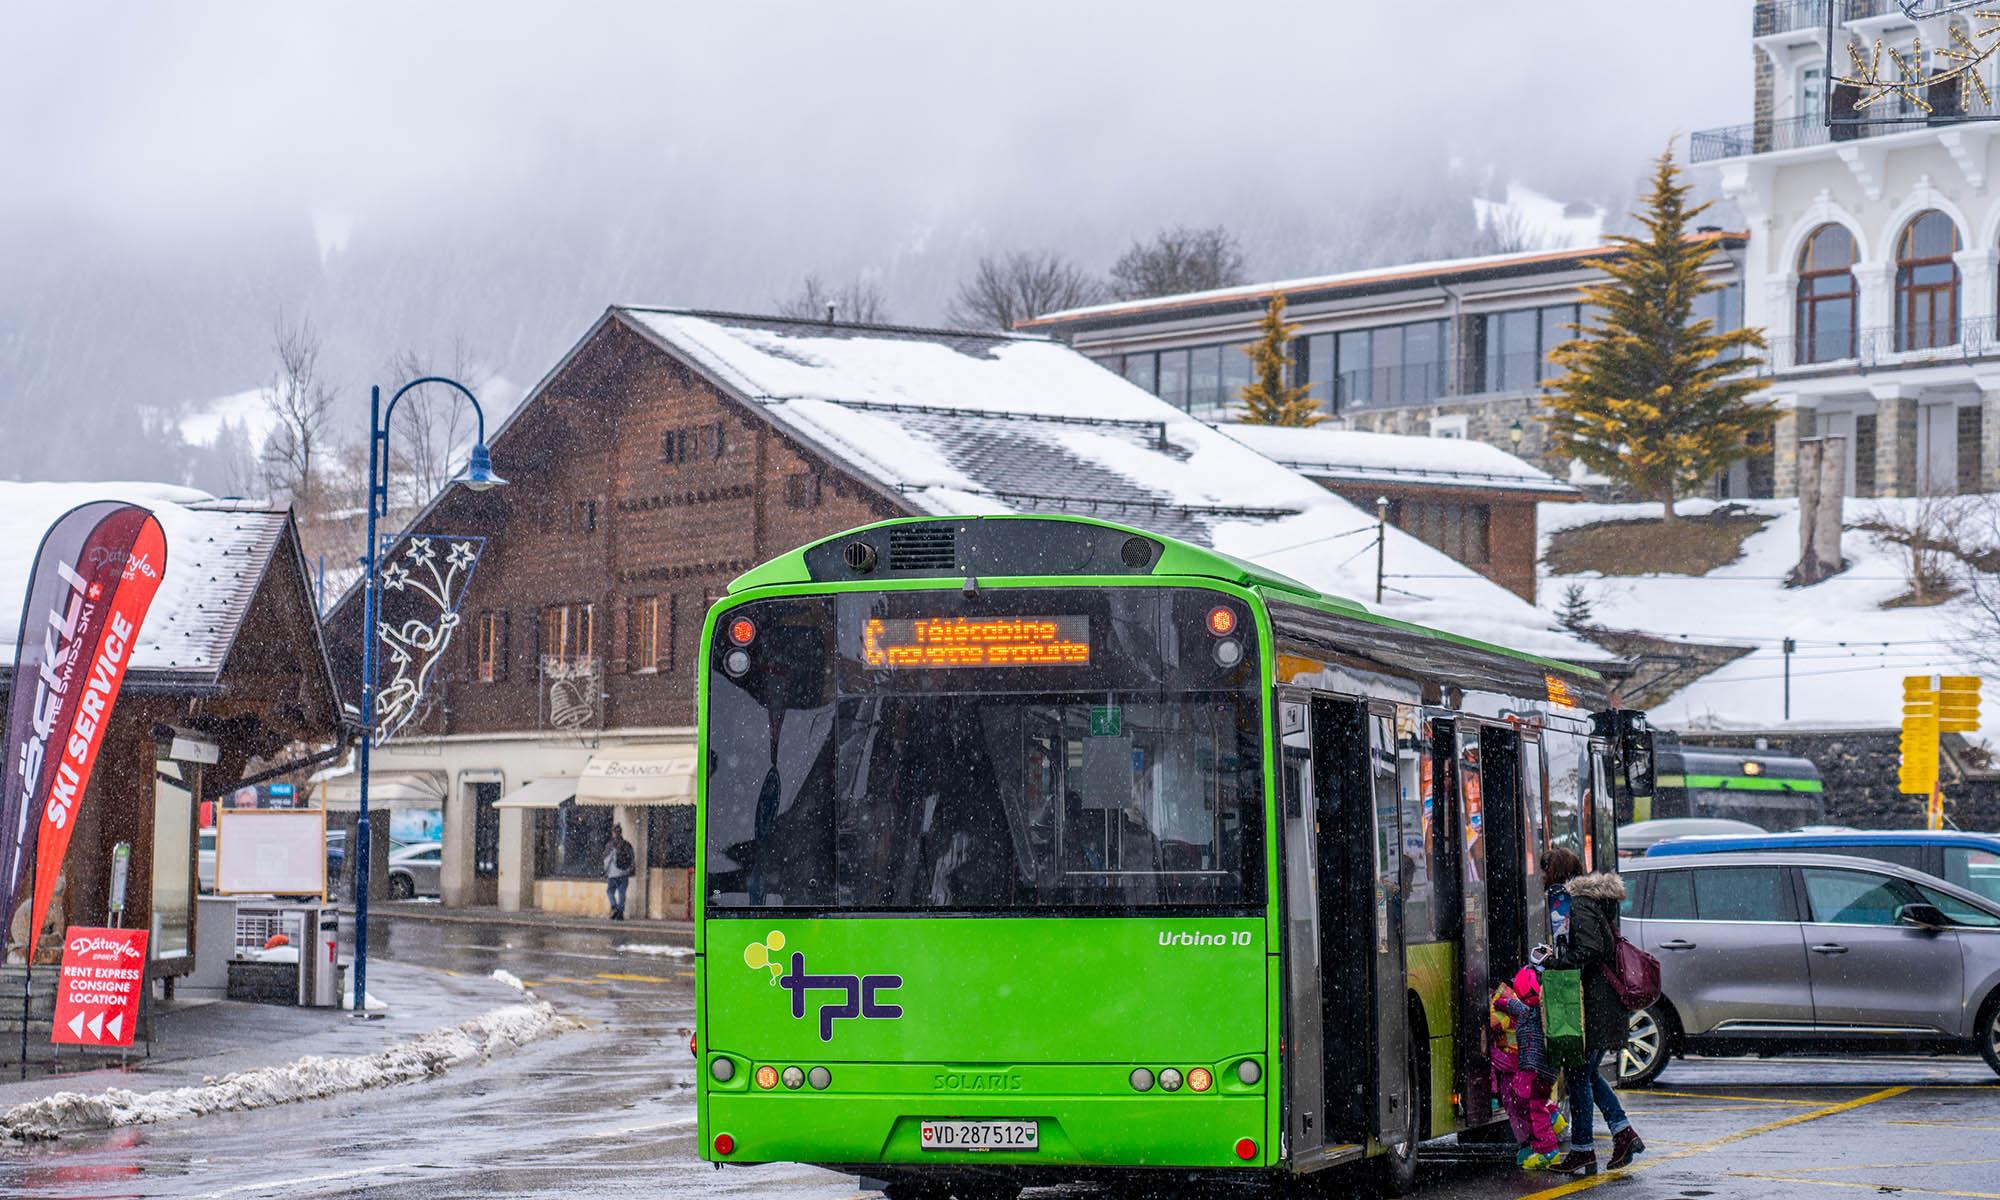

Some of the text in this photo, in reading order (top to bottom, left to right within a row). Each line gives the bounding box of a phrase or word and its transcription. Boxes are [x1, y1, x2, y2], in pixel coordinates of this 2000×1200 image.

[888, 643, 984, 665] naette
[49, 603, 95, 734] THE SWISS SKI
[12, 560, 88, 896] ÖCKLI
[47, 611, 133, 830] SKI SERVICE
[70, 937, 140, 958] Dätwyler
[1158, 930, 1252, 946] Urbino 10
[64, 966, 139, 980] RENT EXPRESS
[70, 980, 130, 992] CONSIGNE
[780, 951, 904, 1042] tpc
[69, 993, 127, 1005] LOCATION
[934, 1074, 1023, 1091] SOLARIS
